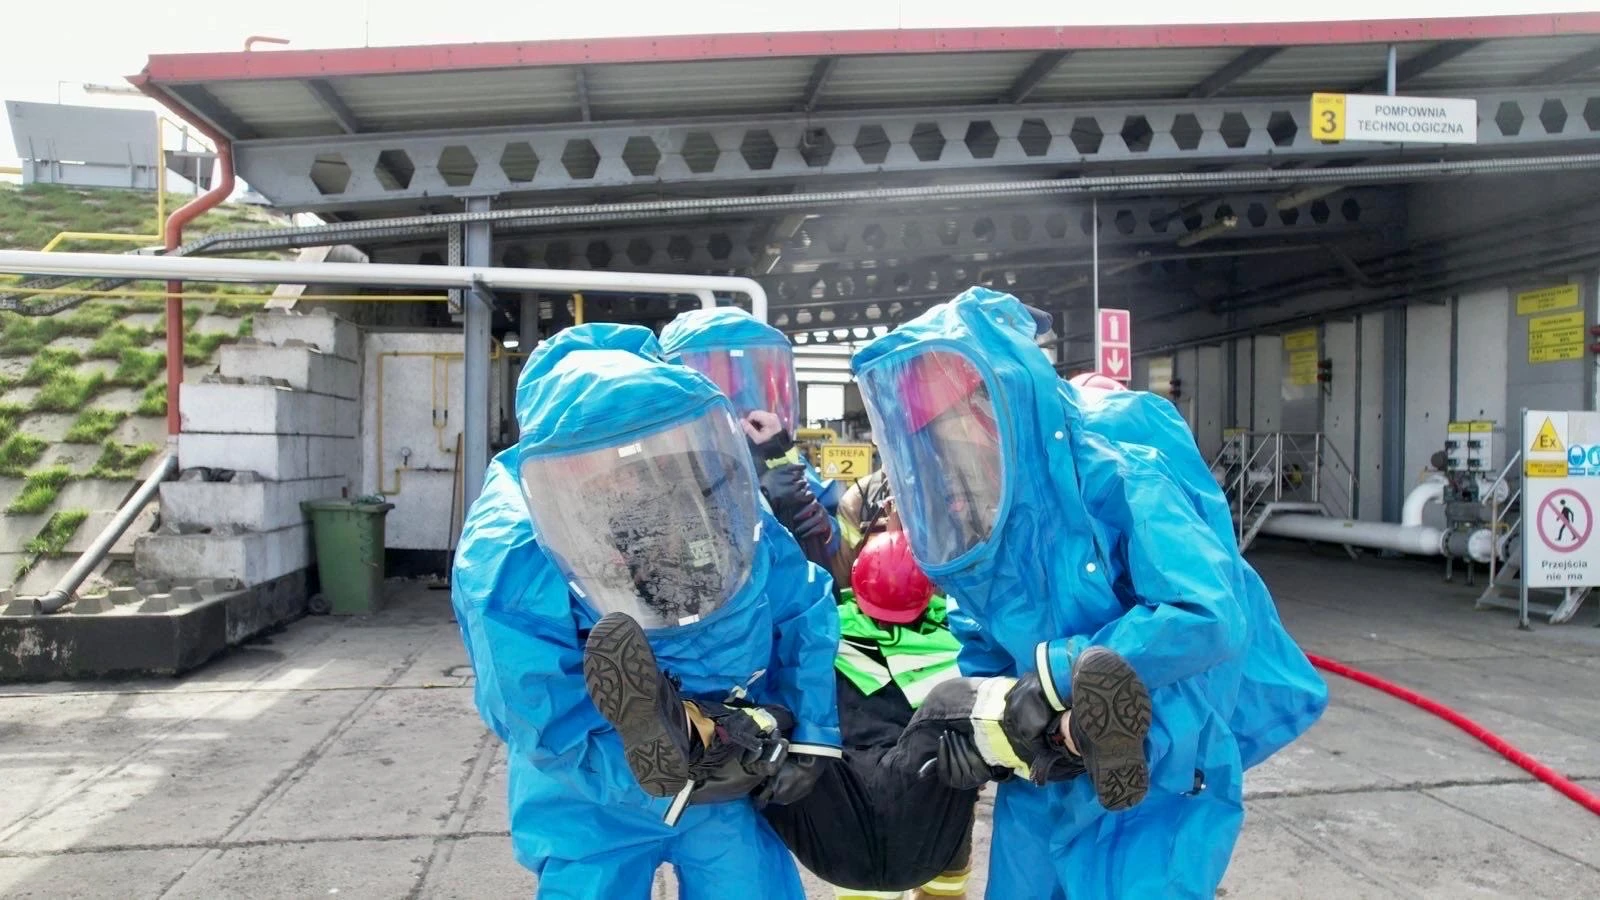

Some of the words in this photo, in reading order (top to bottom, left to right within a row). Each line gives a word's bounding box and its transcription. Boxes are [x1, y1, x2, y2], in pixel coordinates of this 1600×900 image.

[1375, 105, 1447, 118] POMPOWNIA
[1320, 110, 1337, 133] 3
[1358, 119, 1465, 134] TECHNOLOGICZNA
[1540, 434, 1557, 448] Ex
[828, 449, 865, 457] STREFA
[841, 460, 854, 475] 2
[1541, 560, 1588, 571] Przejścia
[1546, 572, 1562, 580] nie
